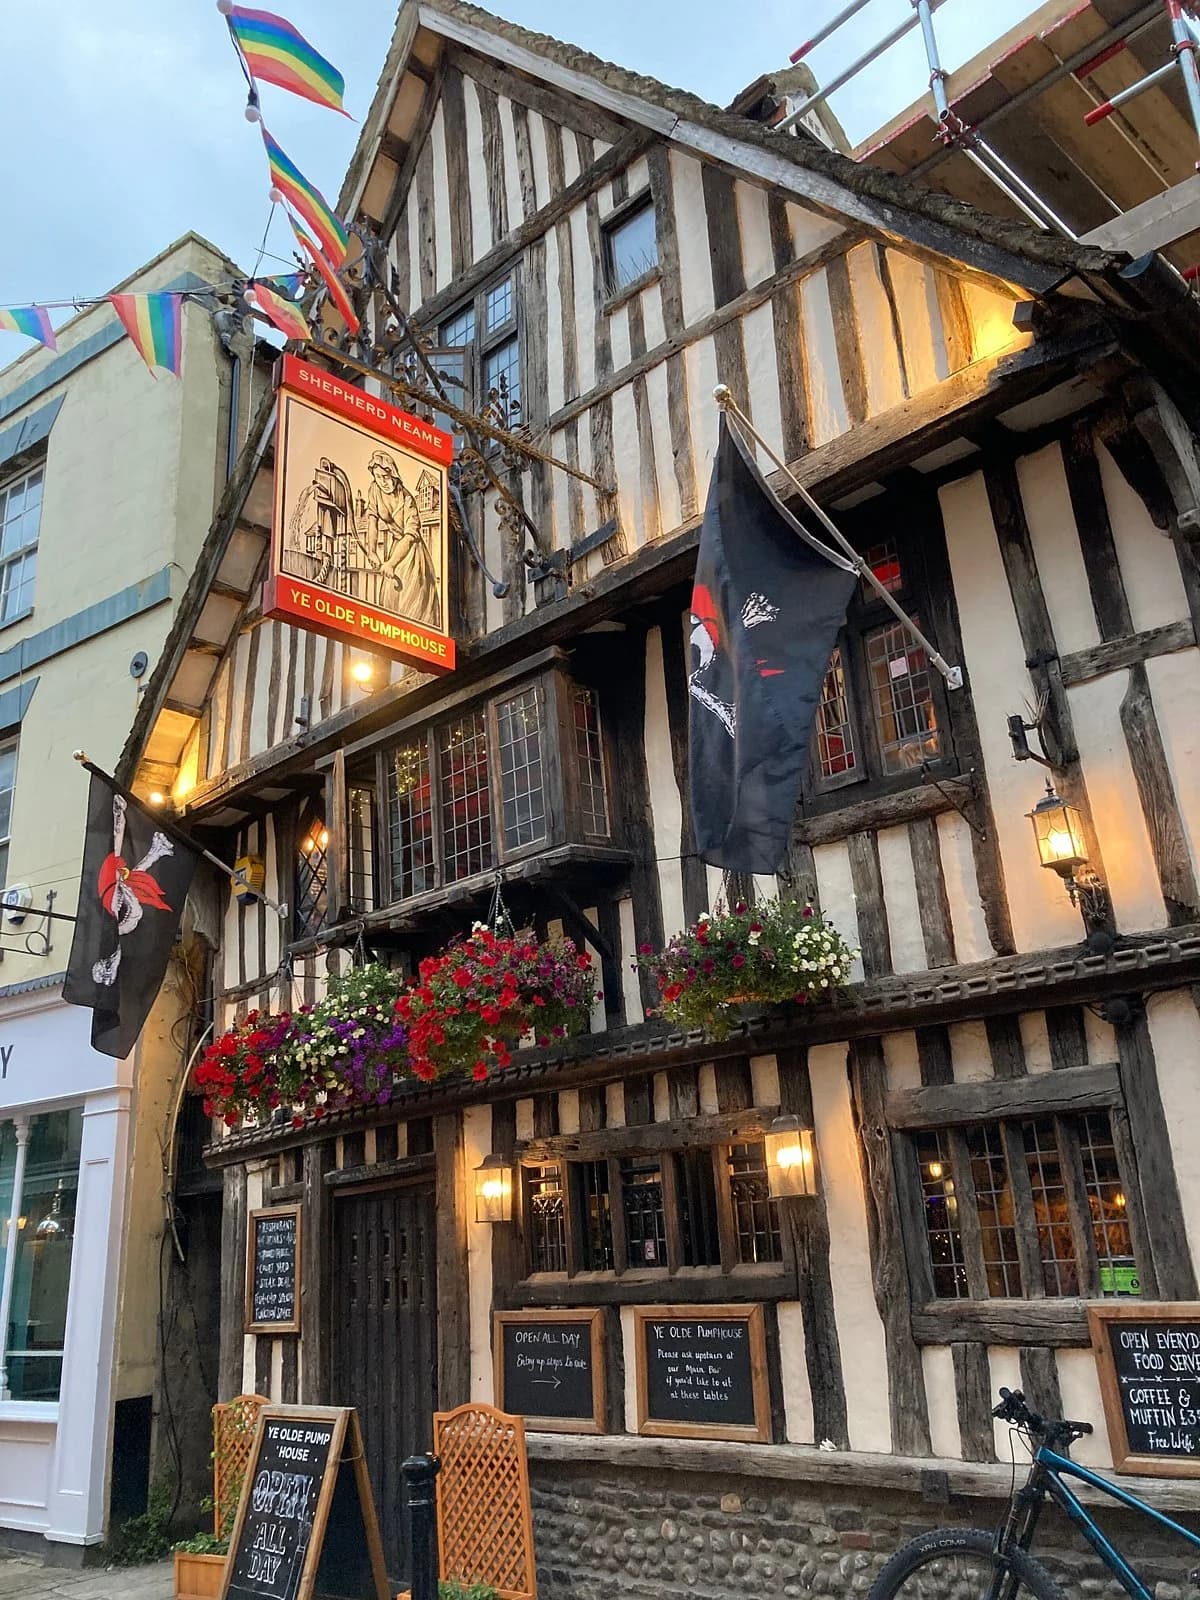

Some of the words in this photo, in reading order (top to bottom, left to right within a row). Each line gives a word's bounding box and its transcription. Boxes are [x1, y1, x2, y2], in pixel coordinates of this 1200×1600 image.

[299, 369, 387, 420] SHEPHERD
[392, 415, 442, 449] NEAME
[290, 589, 311, 609] YE
[315, 598, 355, 625] OLDE
[360, 614, 446, 657] PUMPHOUSE
[515, 1331, 540, 1343] OPEN
[542, 1331, 560, 1344] ALL
[561, 1333, 580, 1348] DAY
[654, 1325, 665, 1339] YE
[669, 1326, 692, 1339] OLDE
[697, 1325, 743, 1340] PUMPHOUSE
[1120, 1328, 1149, 1352] OPEN
[1155, 1328, 1200, 1352] EVERYD
[517, 1353, 535, 1372] Entry
[536, 1359, 545, 1372] up
[546, 1357, 563, 1372] steps
[565, 1355, 573, 1367] to
[658, 1349, 678, 1359] Please
[681, 1350, 693, 1359] ask
[695, 1351, 723, 1362] upstairs
[726, 1351, 734, 1360] at
[1133, 1352, 1164, 1369] FOOD
[667, 1364, 679, 1373] our
[685, 1364, 705, 1374] Main
[708, 1365, 721, 1374] Bar
[696, 1376, 709, 1386] like
[712, 1377, 720, 1386] to
[722, 1376, 733, 1387] sit
[670, 1390, 679, 1399] at
[680, 1389, 700, 1399] these
[703, 1389, 729, 1400] tables
[1130, 1388, 1172, 1404] COFFEE
[1179, 1388, 1191, 1408] &
[1130, 1406, 1176, 1428] MUFFIN
[268, 1426, 280, 1439] YE
[280, 1428, 303, 1442] OLDE
[305, 1431, 331, 1445] PUMP
[1148, 1430, 1170, 1449] Free
[1170, 1429, 1194, 1453] Wifi
[278, 1448, 310, 1462] HOUSE
[252, 1470, 314, 1520] OPEN
[253, 1522, 286, 1555] ALL
[247, 1551, 281, 1585] DAY
